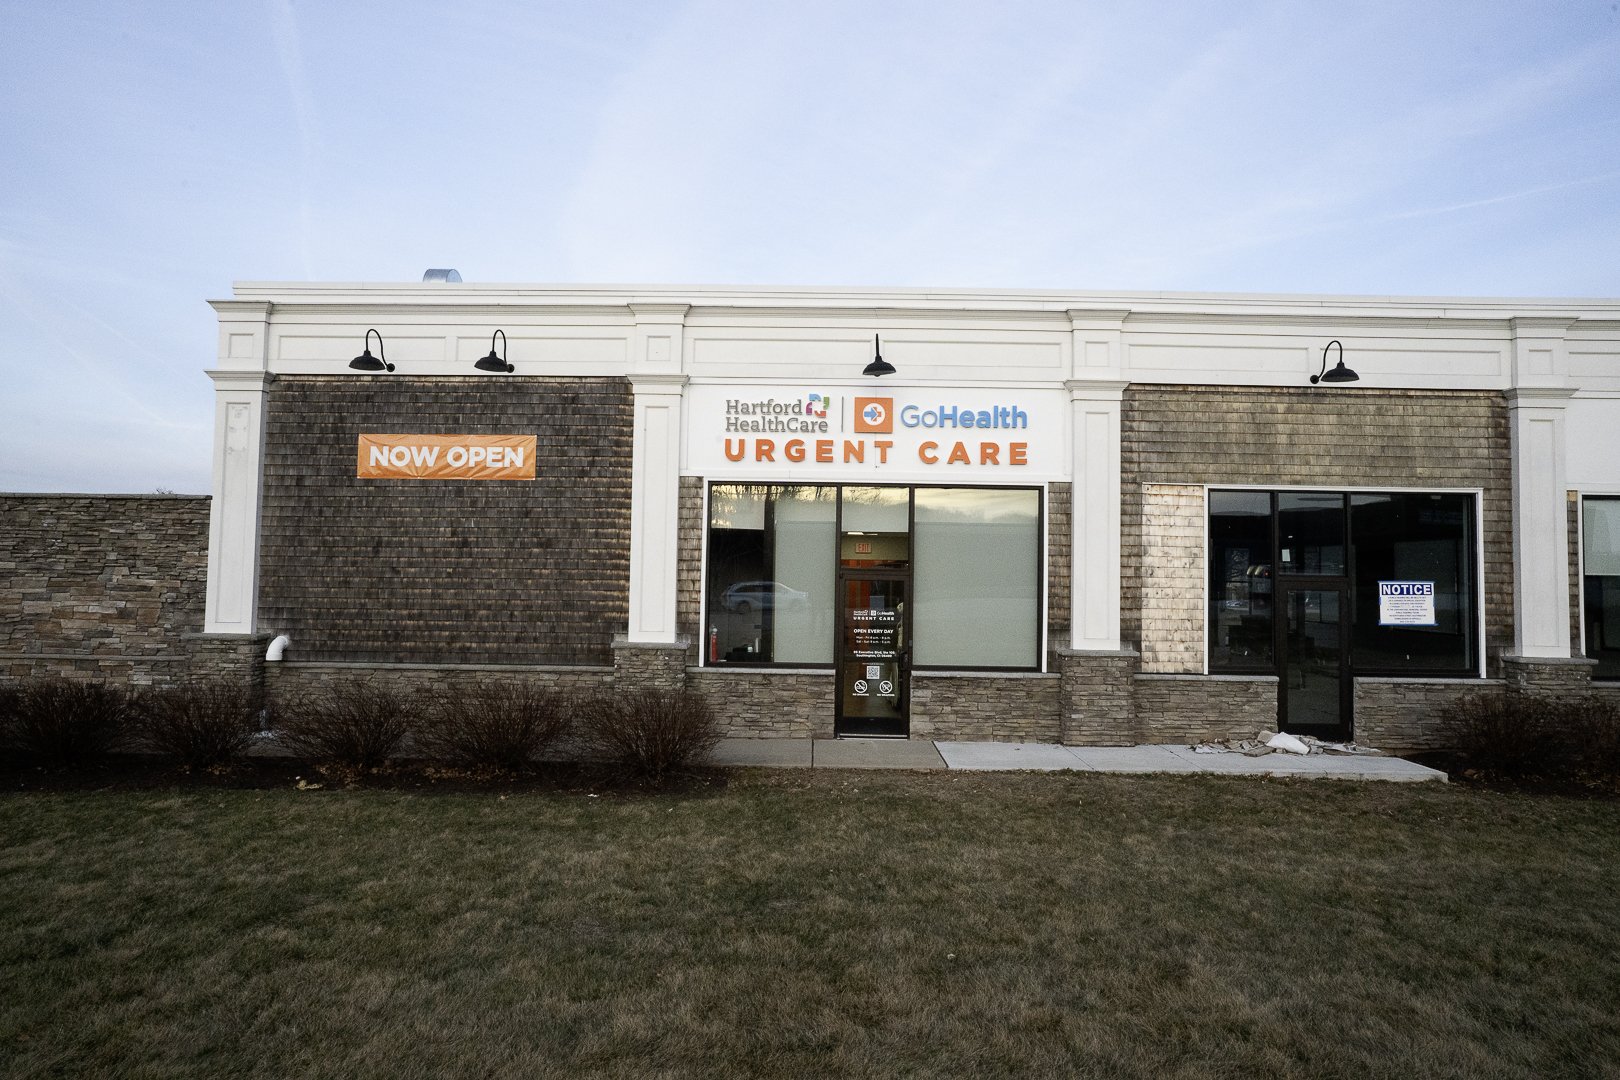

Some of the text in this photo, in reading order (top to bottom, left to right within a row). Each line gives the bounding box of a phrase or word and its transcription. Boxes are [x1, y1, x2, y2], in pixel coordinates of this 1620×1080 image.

[725, 399, 803, 416] Hartford
[725, 416, 829, 433] HealthCare
[900, 404, 1028, 429] GoHealth
[369, 445, 524, 468] NOW OPEN
[724, 438, 1028, 465] URGENT CARE
[858, 543, 870, 552] EXIT
[1382, 584, 1432, 595] NOTICE
